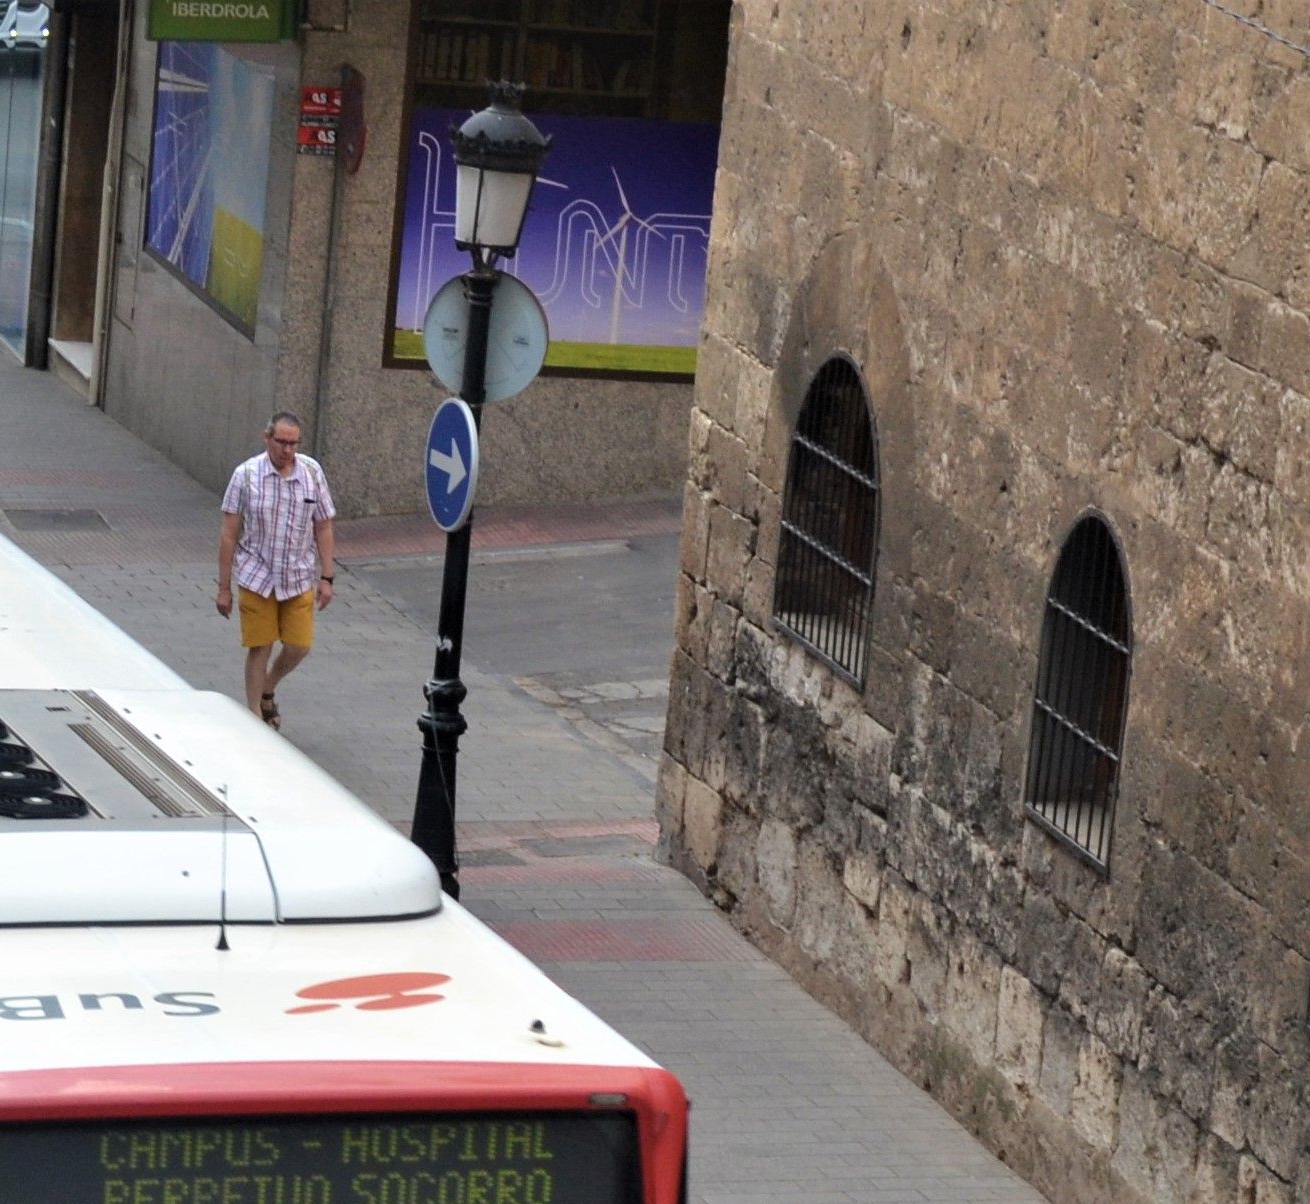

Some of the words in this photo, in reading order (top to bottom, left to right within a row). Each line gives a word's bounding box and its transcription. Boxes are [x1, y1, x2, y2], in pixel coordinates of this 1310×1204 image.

[172, 2, 269, 18] IBERDROLA
[99, 1128, 281, 1170] CAMPUS
[341, 1122, 554, 1163] HOSPITAL
